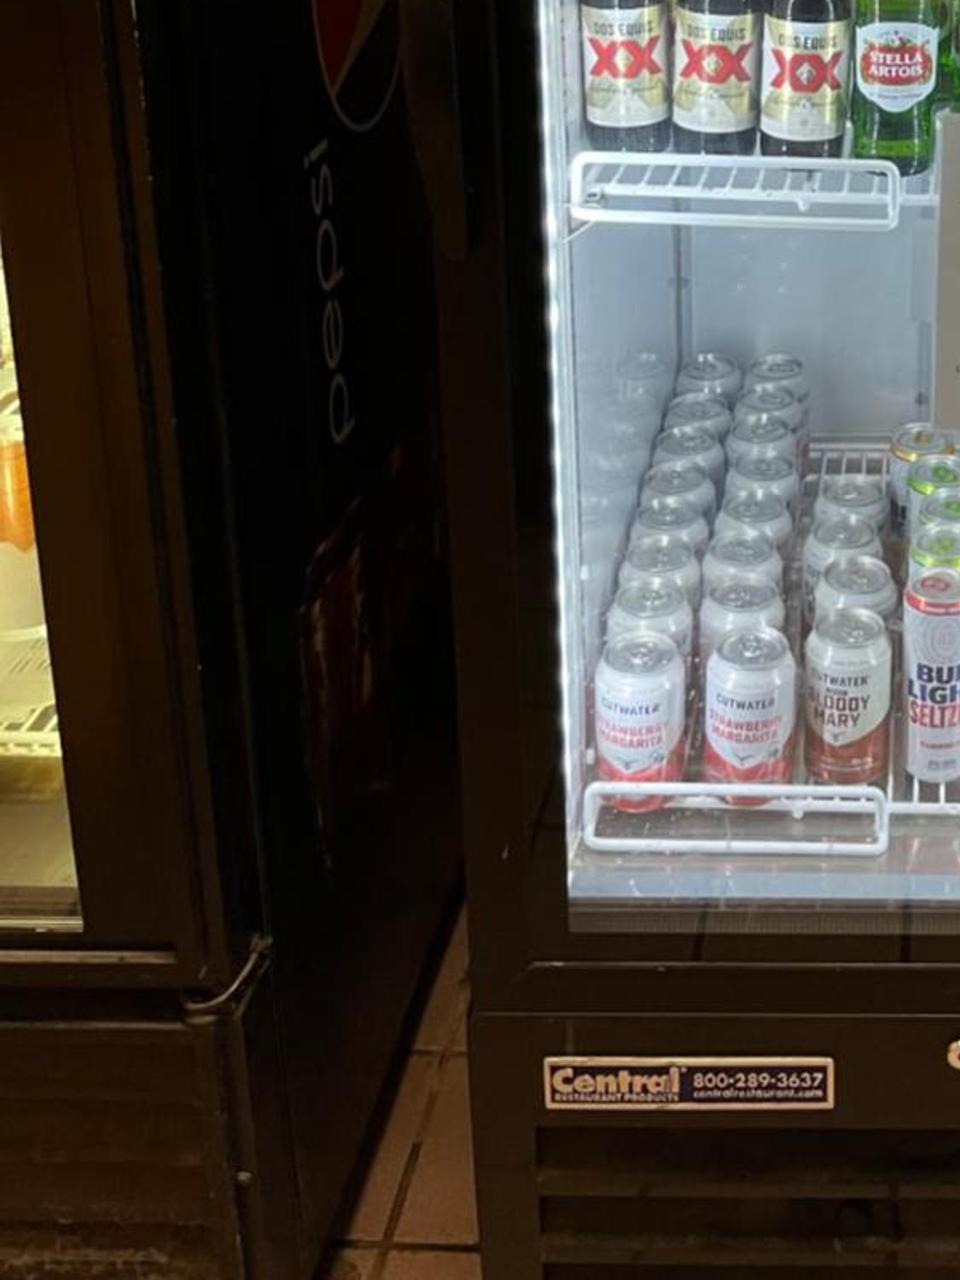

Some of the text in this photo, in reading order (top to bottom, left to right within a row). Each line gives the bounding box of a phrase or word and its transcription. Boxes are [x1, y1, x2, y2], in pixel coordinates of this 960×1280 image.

[710, 27, 747, 42] EQUIS
[587, 34, 662, 80] XX
[679, 38, 753, 85] XX
[870, 49, 923, 64] STELLA
[771, 47, 844, 94] XX
[869, 63, 924, 78] ARTOIS
[303, 136, 356, 446] pepsi
[816, 672, 869, 688] TWATER
[552, 1066, 680, 1095] Central
[554, 1092, 680, 1103] RESTAURANT PRODUCTS
